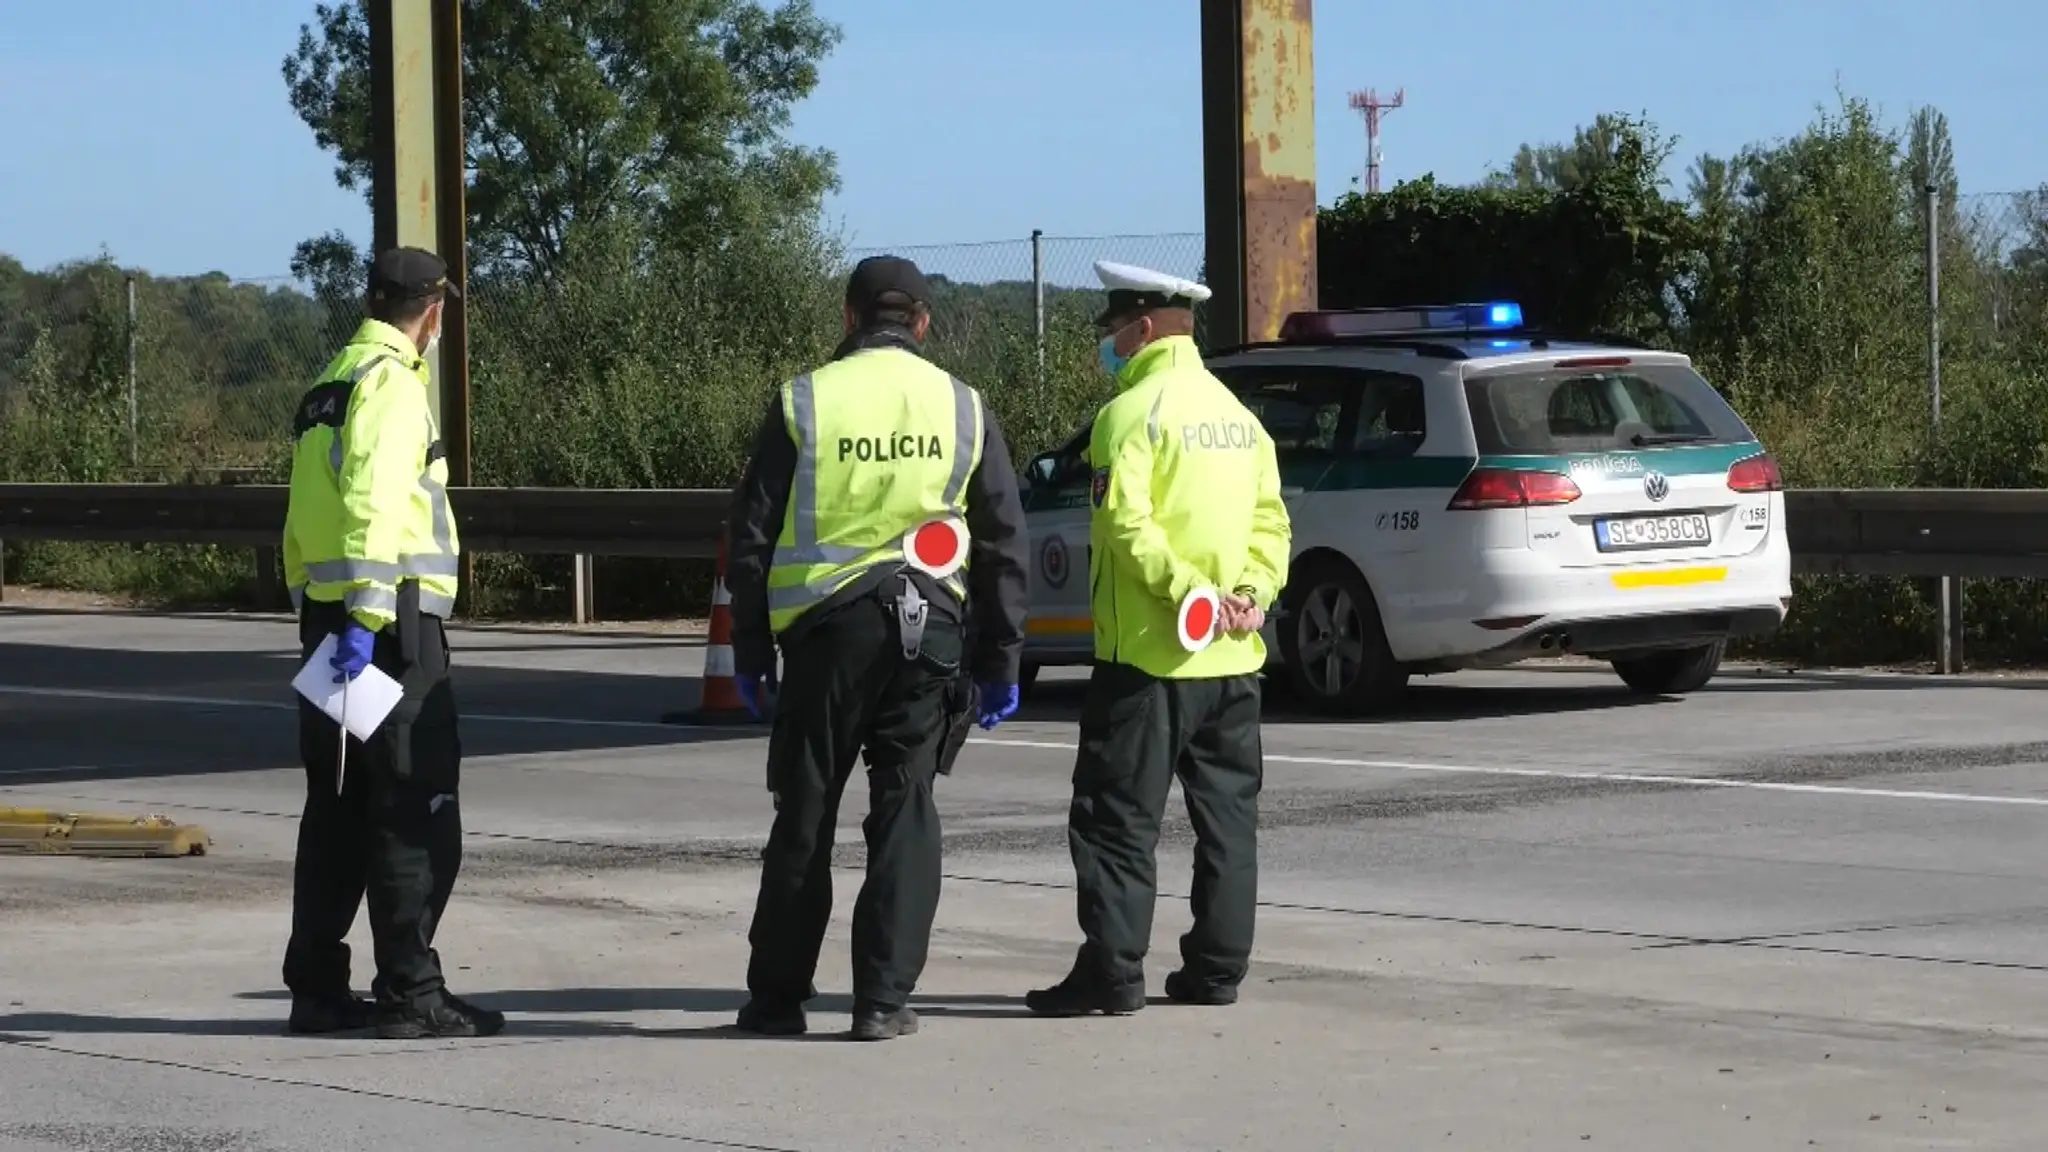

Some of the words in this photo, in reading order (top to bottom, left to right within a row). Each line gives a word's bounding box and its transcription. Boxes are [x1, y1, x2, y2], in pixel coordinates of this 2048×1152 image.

[838, 431, 943, 462] POLÍCIA
[1392, 510, 1420, 531] 158
[1749, 507, 1767, 521] 158
[1610, 521, 1636, 543] SE
[1645, 516, 1706, 541] 358CB
